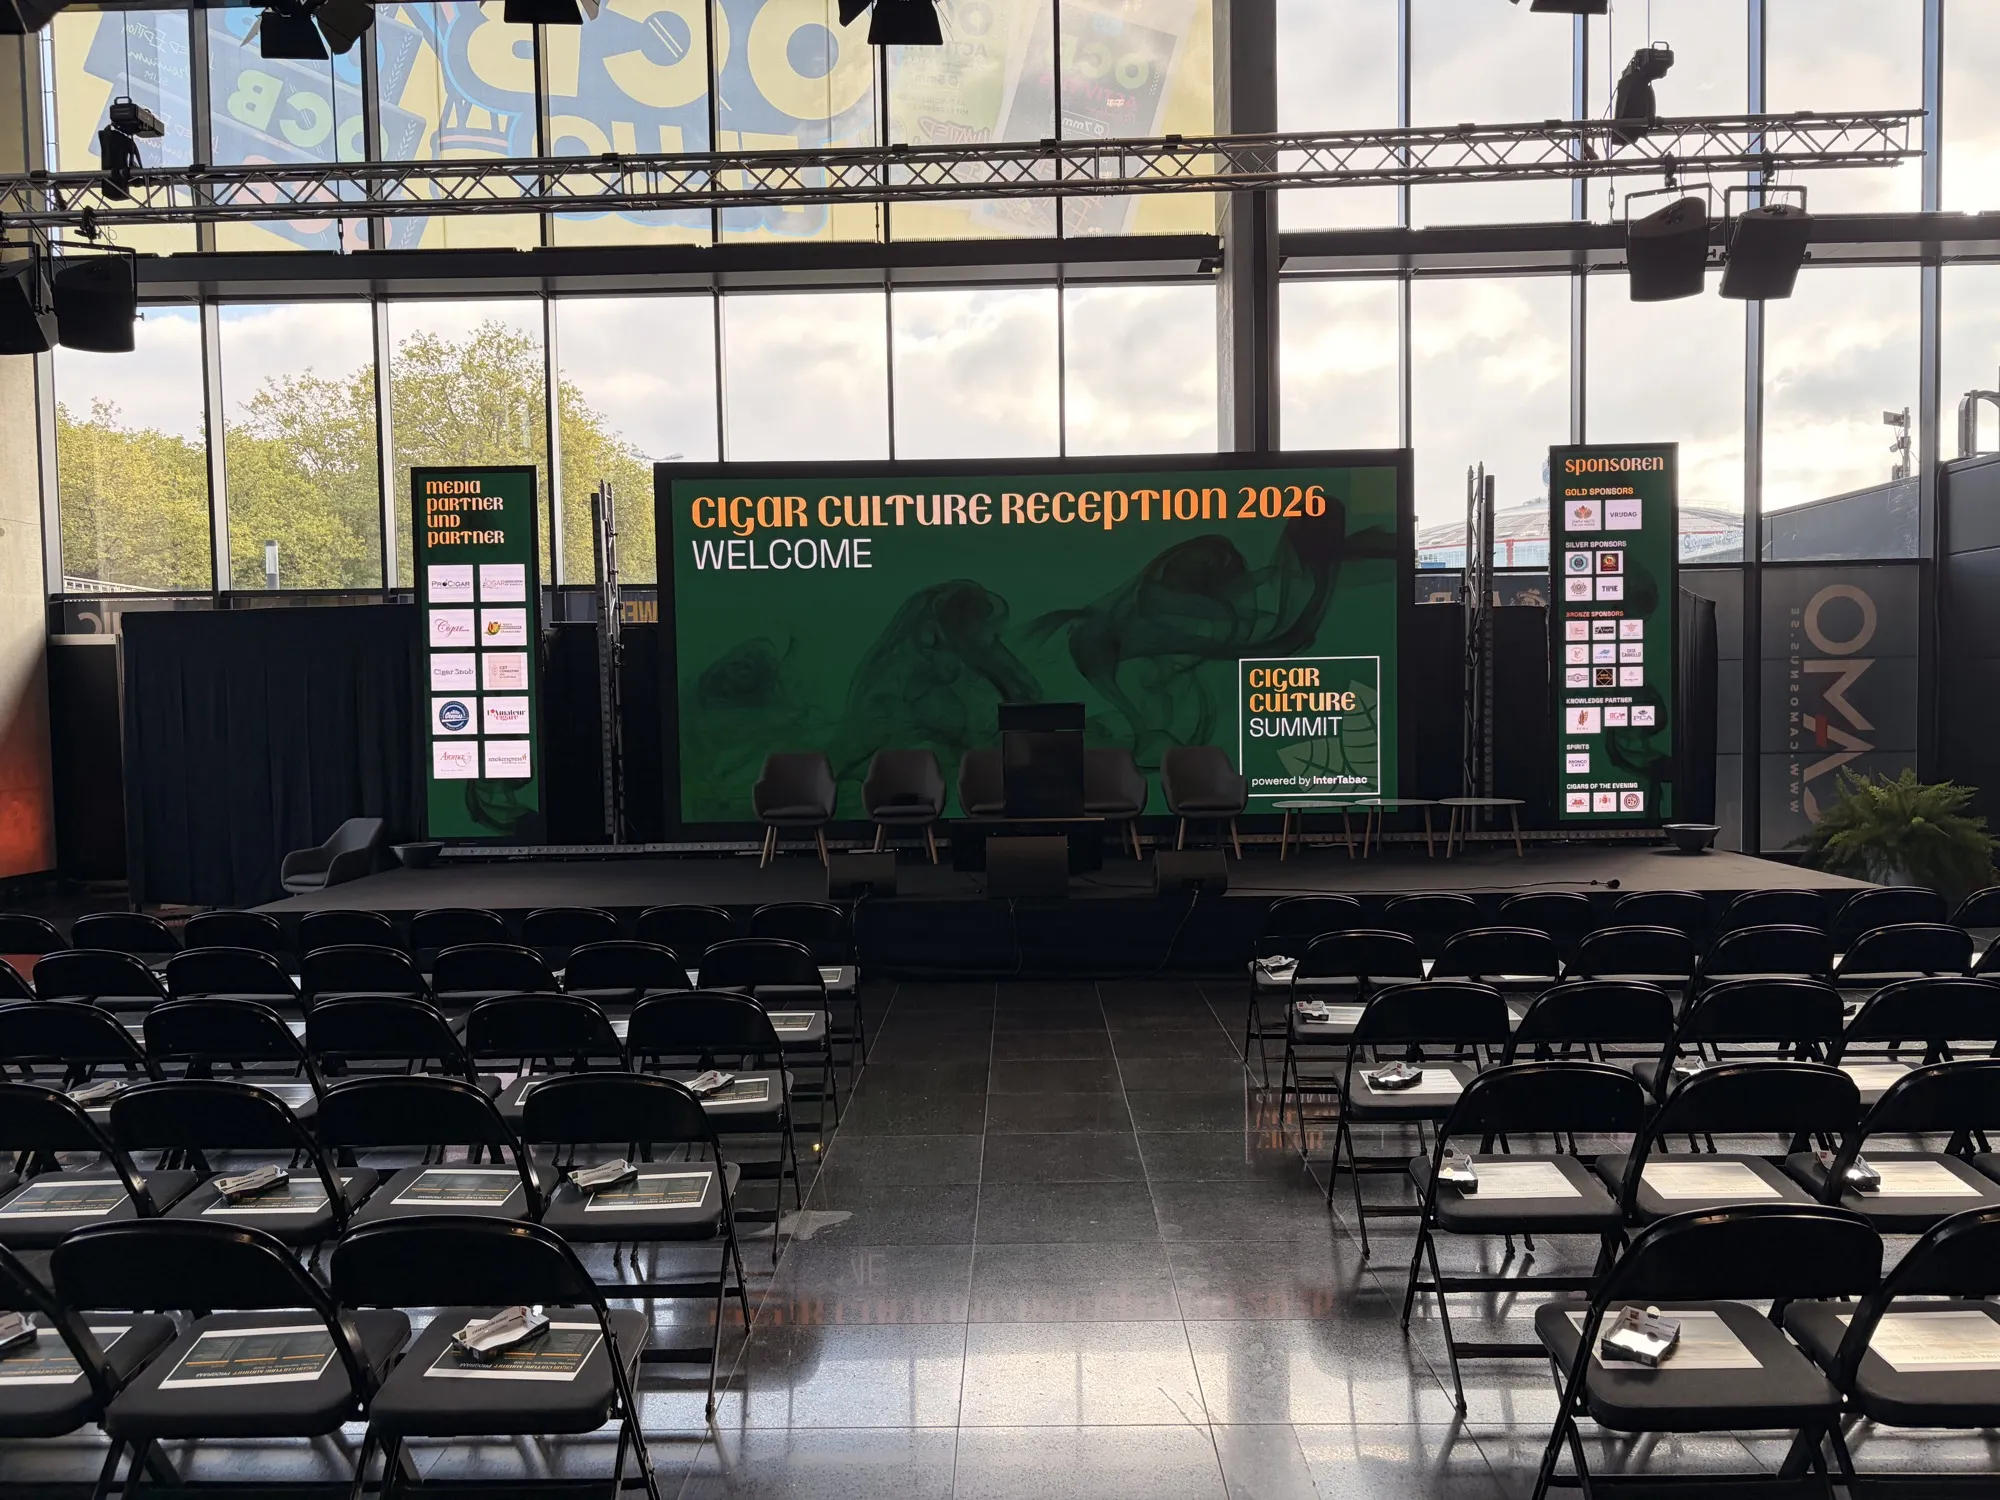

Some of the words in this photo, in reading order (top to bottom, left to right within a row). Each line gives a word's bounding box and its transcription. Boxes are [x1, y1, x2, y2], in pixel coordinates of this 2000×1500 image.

[1565, 488, 1588, 496] GOLD
[1589, 487, 1634, 496] SPONSORS
[427, 496, 504, 514] PARTNER
[692, 496, 807, 536] CIGAR
[818, 493, 992, 526] CULTURE
[1001, 488, 1227, 530] RECEPTION
[1237, 485, 1326, 518] 2026
[428, 530, 504, 548] PARTNER
[1565, 541, 1589, 549] SILVER
[1590, 540, 1627, 548] SPONSORS
[692, 539, 872, 569] WELCOME
[1249, 668, 1320, 692] CIGAR
[1249, 691, 1356, 713] CULTURE
[1249, 716, 1343, 737] SUMMIT
[1251, 776, 1296, 787] powered
[1299, 776, 1311, 786] by
[1313, 775, 1368, 785] InterTabac
